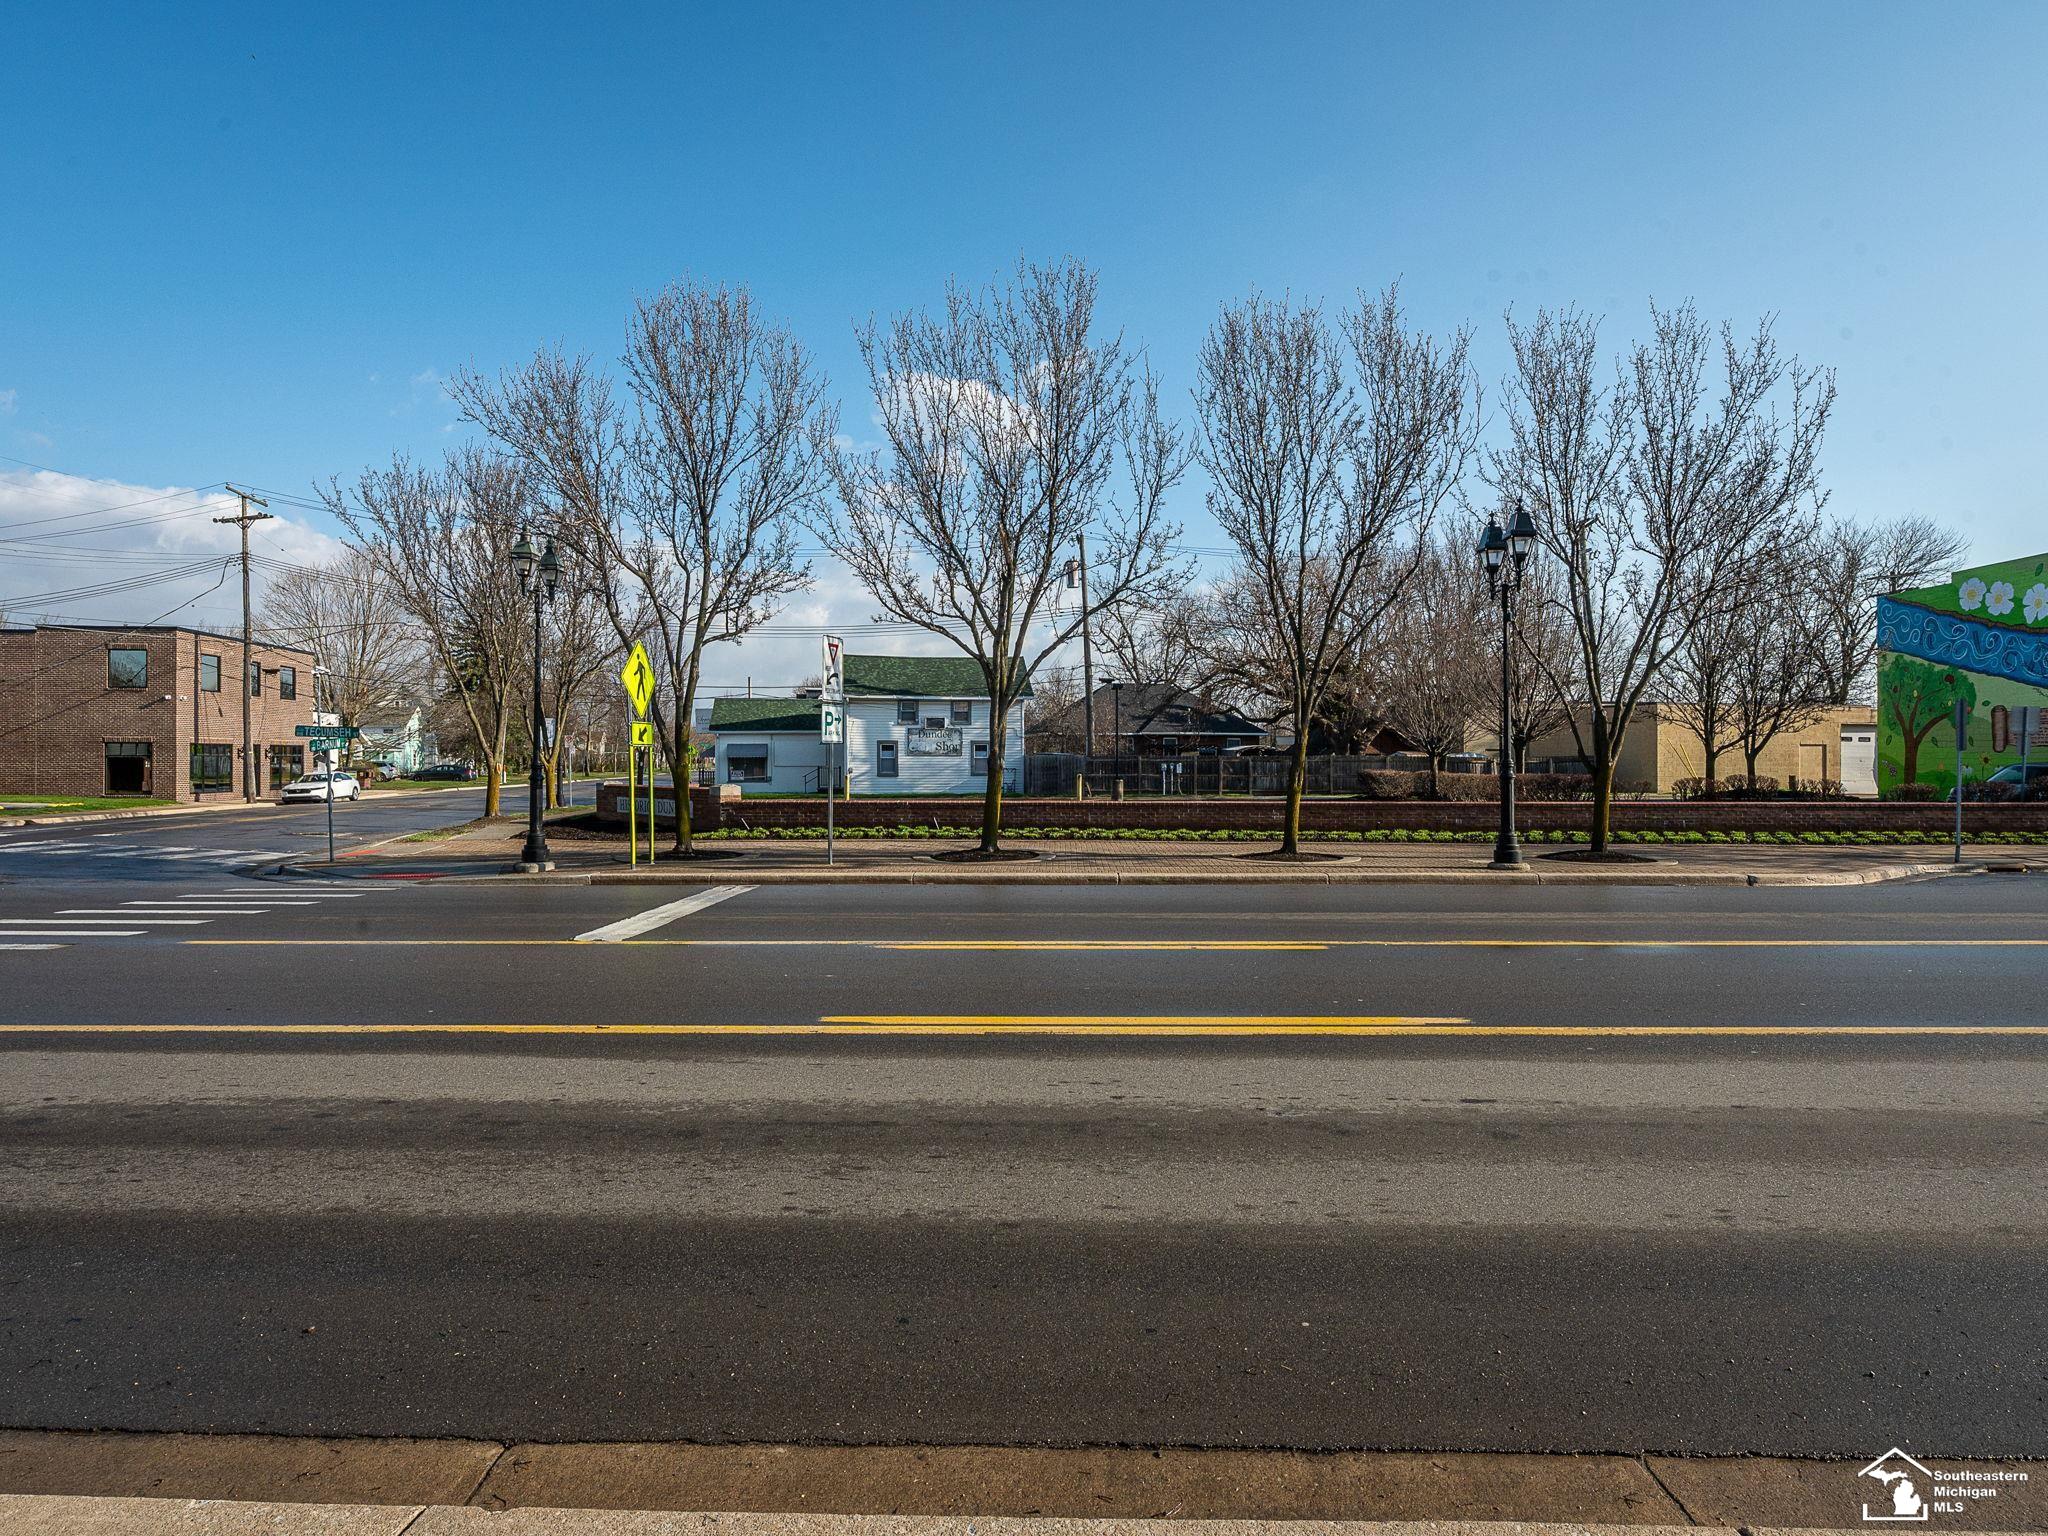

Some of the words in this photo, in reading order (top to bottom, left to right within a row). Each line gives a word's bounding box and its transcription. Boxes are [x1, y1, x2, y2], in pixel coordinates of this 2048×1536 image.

[304, 727, 351, 737] TECUMSEH
[316, 738, 341, 751] BARNUM
[657, 800, 675, 815] DUN
